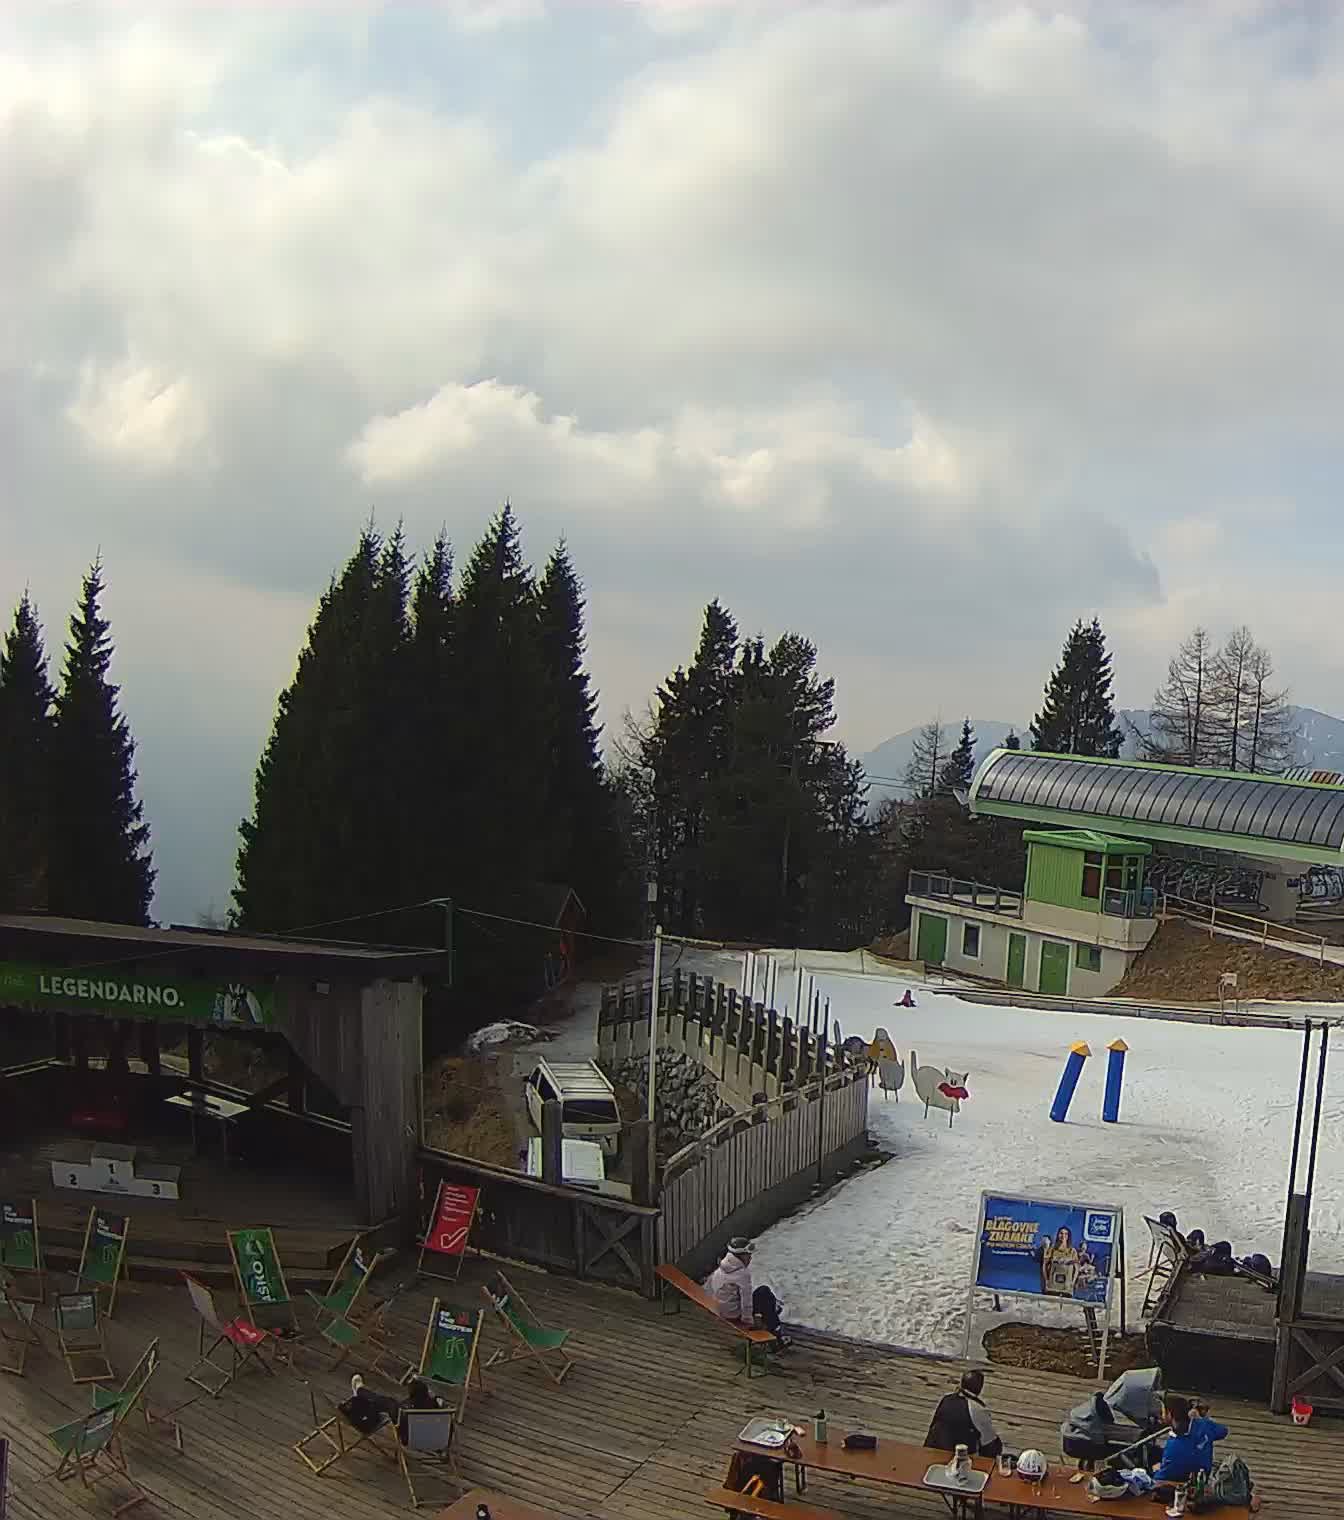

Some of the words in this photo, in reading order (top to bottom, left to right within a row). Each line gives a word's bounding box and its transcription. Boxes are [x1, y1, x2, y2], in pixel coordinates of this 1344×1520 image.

[39, 975, 185, 1008] LEGENDARNO.
[68, 1173, 78, 1186] 2
[151, 1183, 161, 1196] 3
